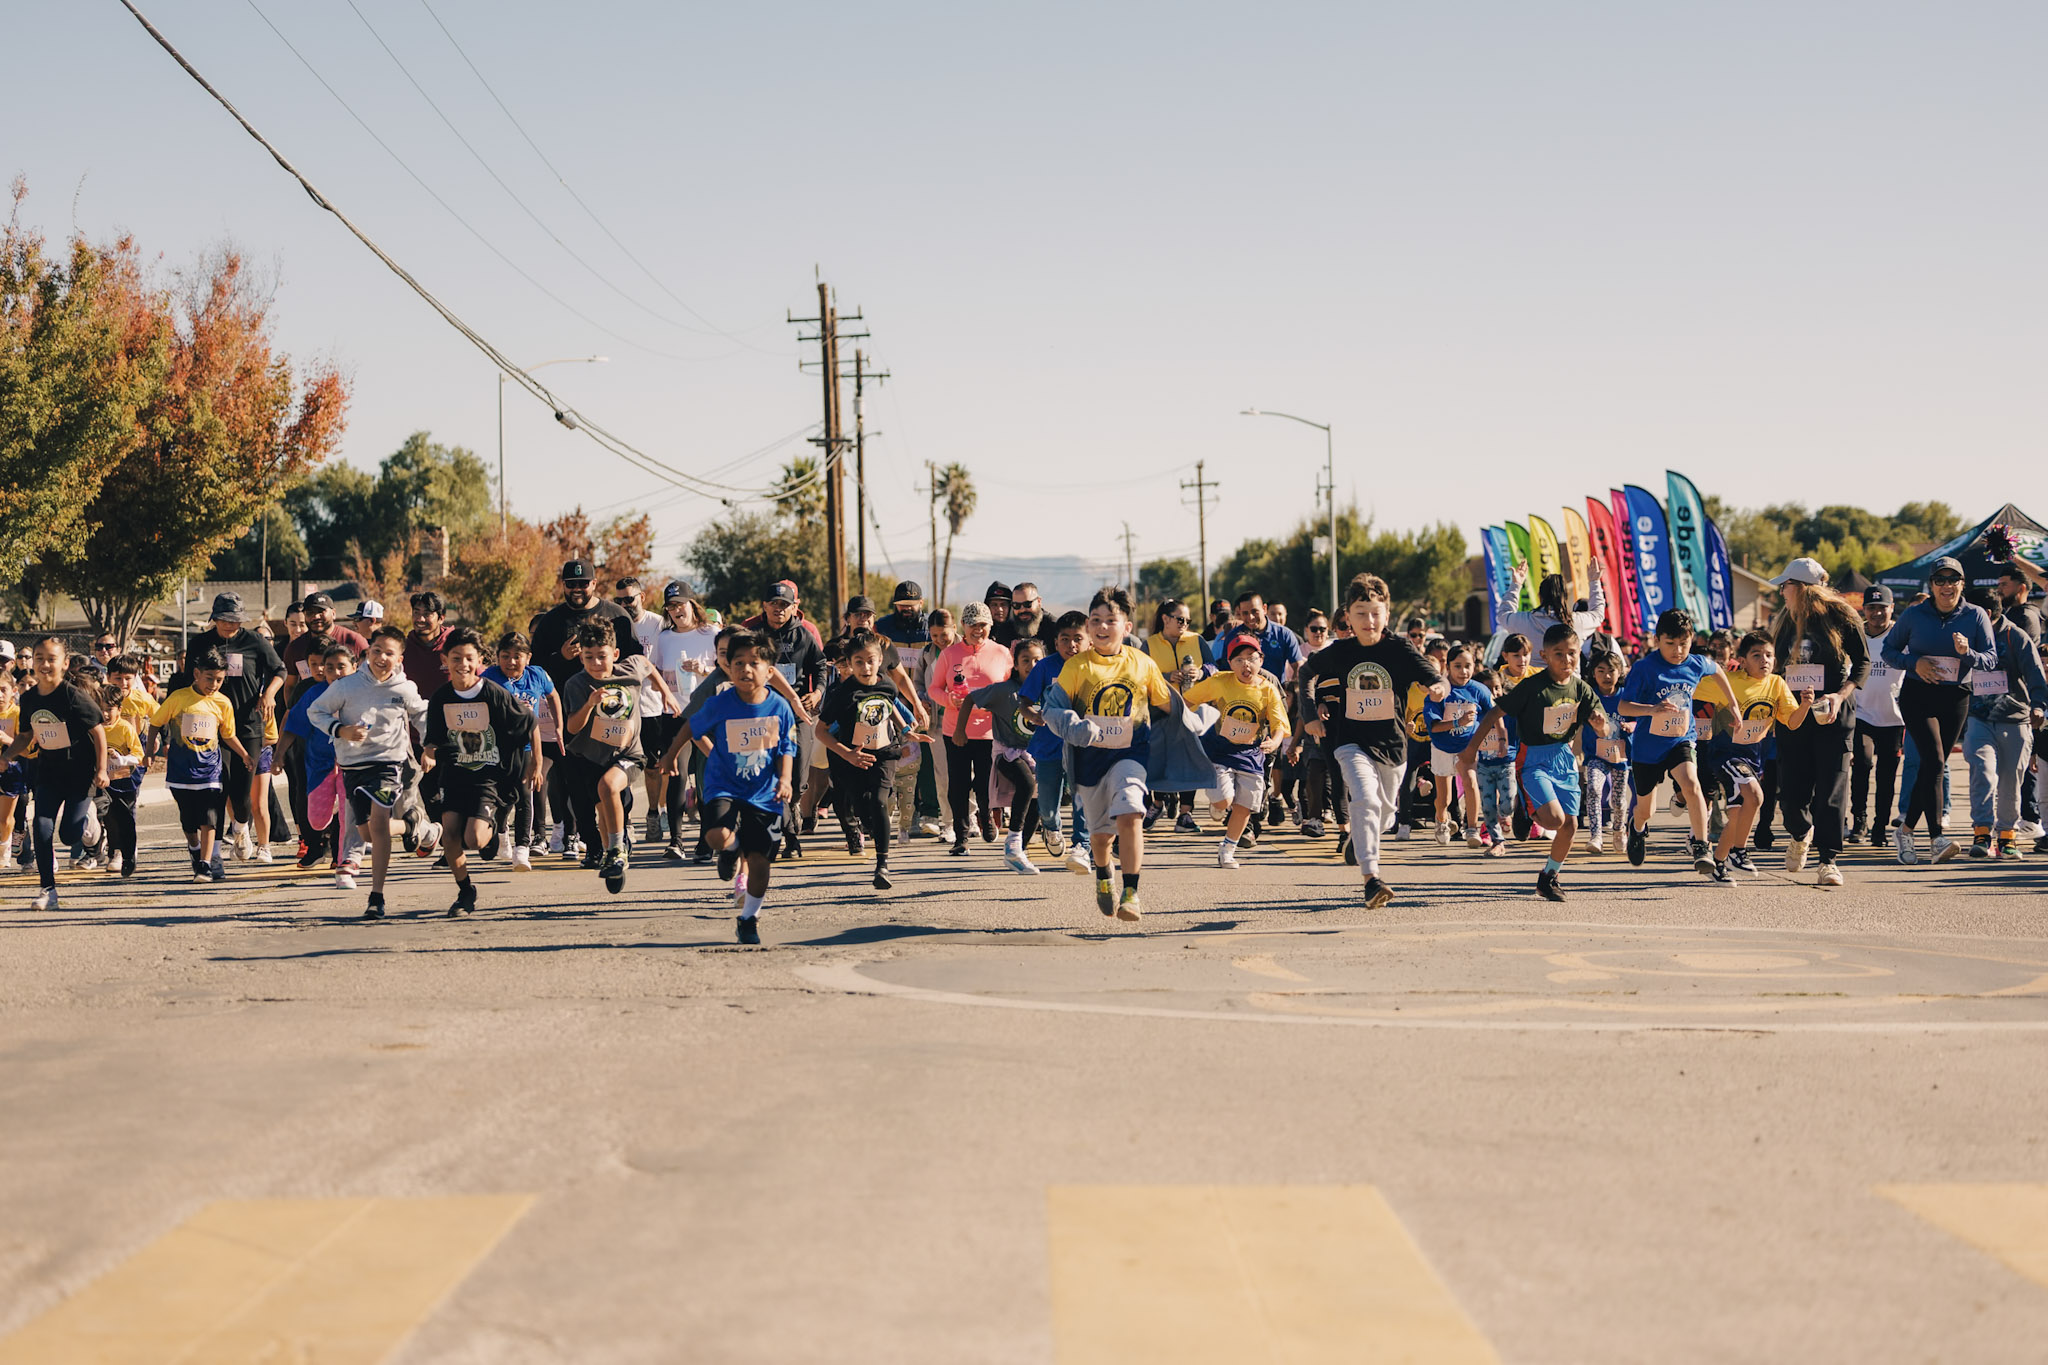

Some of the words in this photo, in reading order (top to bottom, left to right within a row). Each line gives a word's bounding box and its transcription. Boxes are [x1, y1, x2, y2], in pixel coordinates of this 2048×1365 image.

[1786, 675, 1823, 683] PARENT
[1870, 669, 1886, 677] ETTER
[1656, 683, 1680, 699] POLAR
[1974, 680, 2006, 689] PARENT
[1356, 698, 1382, 715] 3RD
[456, 711, 478, 727] 3RD
[1661, 717, 1685, 732] 3RD
[190, 720, 210, 733] 3RD
[602, 726, 626, 739] 3RD
[1229, 727, 1251, 737] 3RD
[40, 729, 57, 744] 3RD
[740, 726, 767, 747] 3RD
